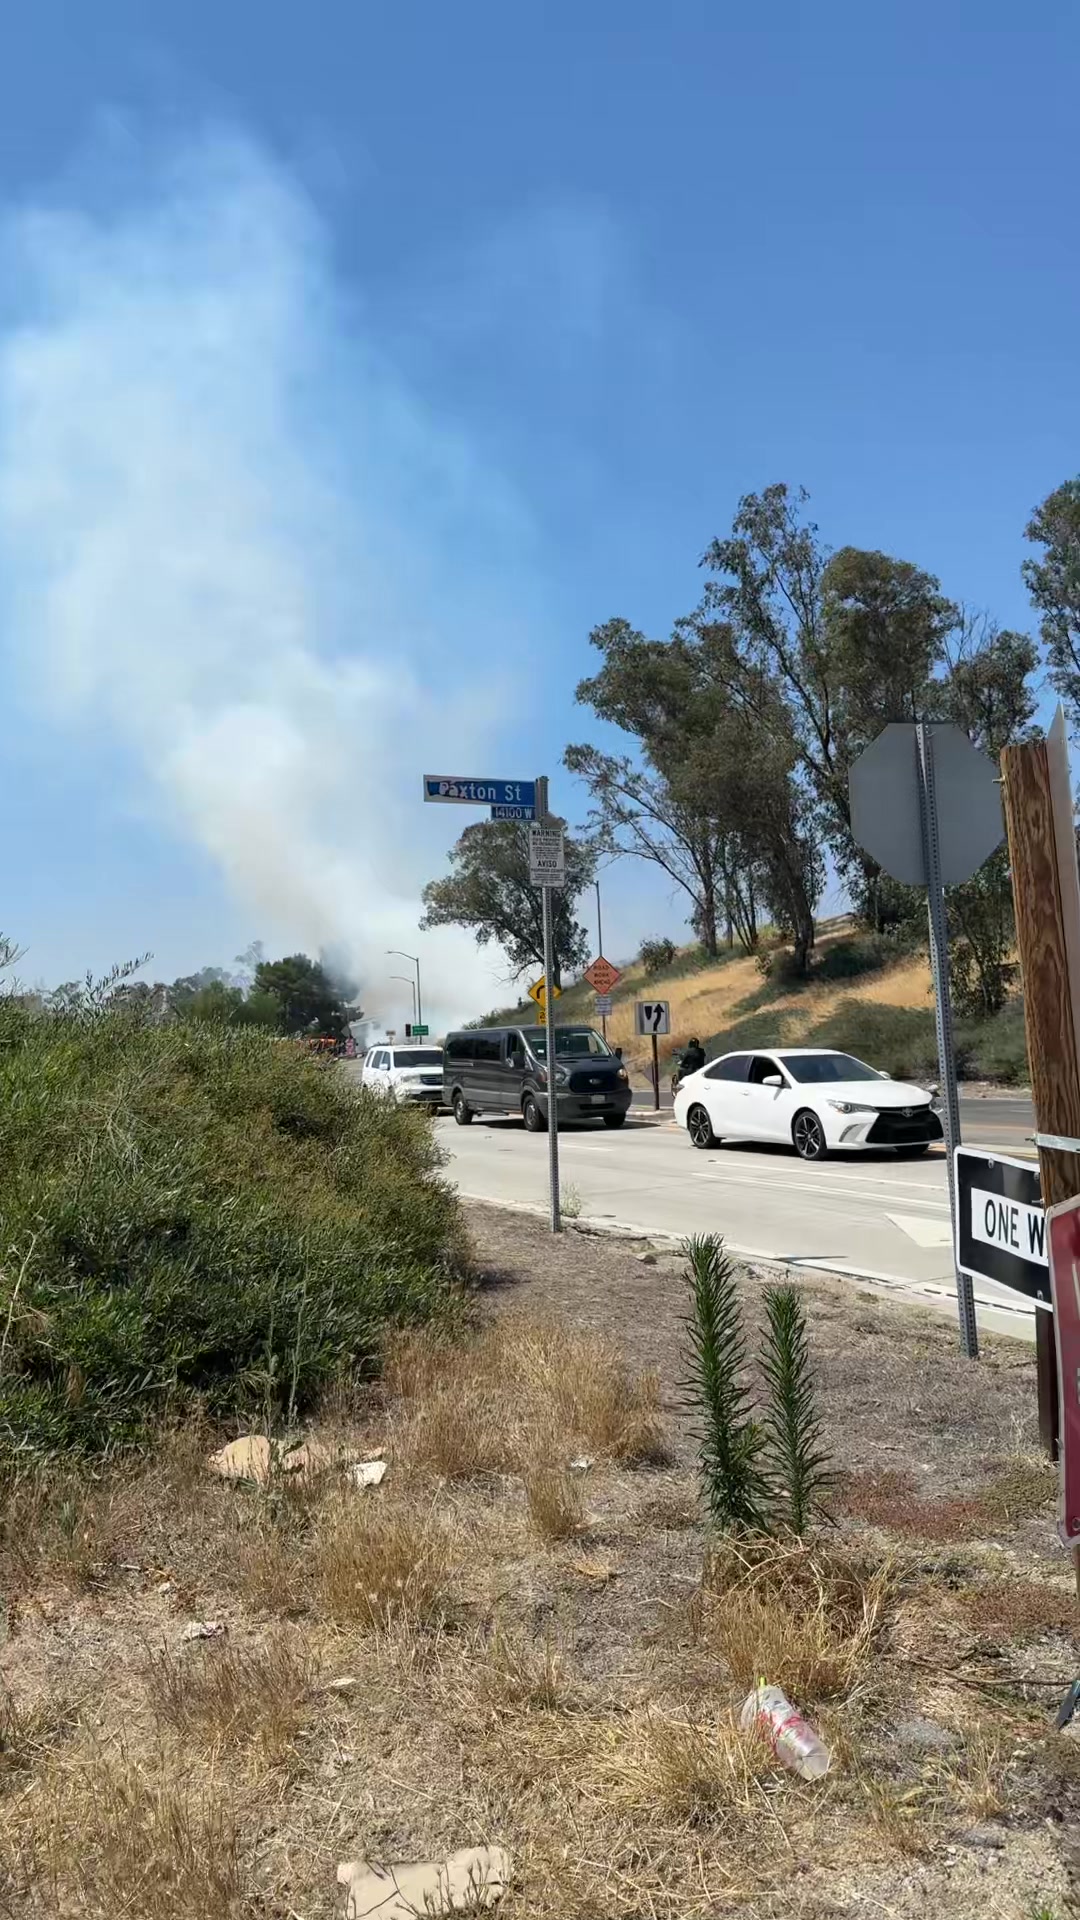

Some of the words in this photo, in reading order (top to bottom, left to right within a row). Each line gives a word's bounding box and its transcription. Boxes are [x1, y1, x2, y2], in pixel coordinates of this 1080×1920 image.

[439, 782, 496, 800] Paxton
[505, 784, 521, 801] St
[495, 807, 522, 819] 14100
[524, 809, 532, 819] W
[537, 860, 557, 868] AVISO
[985, 1199, 1019, 1249] ONE
